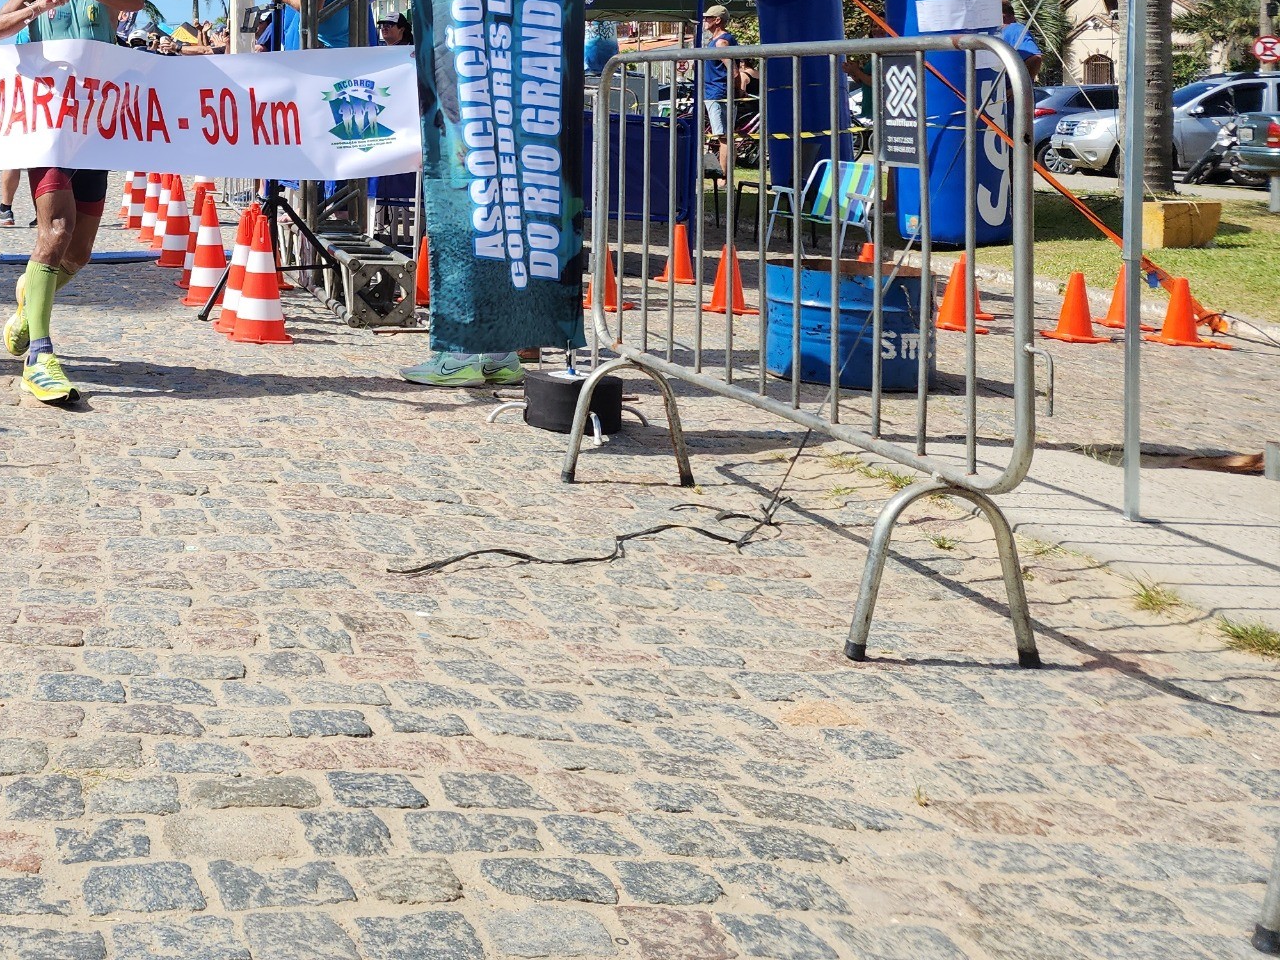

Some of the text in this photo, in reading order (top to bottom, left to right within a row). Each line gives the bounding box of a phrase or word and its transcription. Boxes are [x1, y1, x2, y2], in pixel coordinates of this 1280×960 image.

[177, 117, 190, 130] -
[199, 87, 239, 145] 50
[249, 86, 302, 146] km
[489, 23, 527, 288] CORREDORES
[521, 144, 561, 215] RIO
[527, 222, 560, 280] DO
